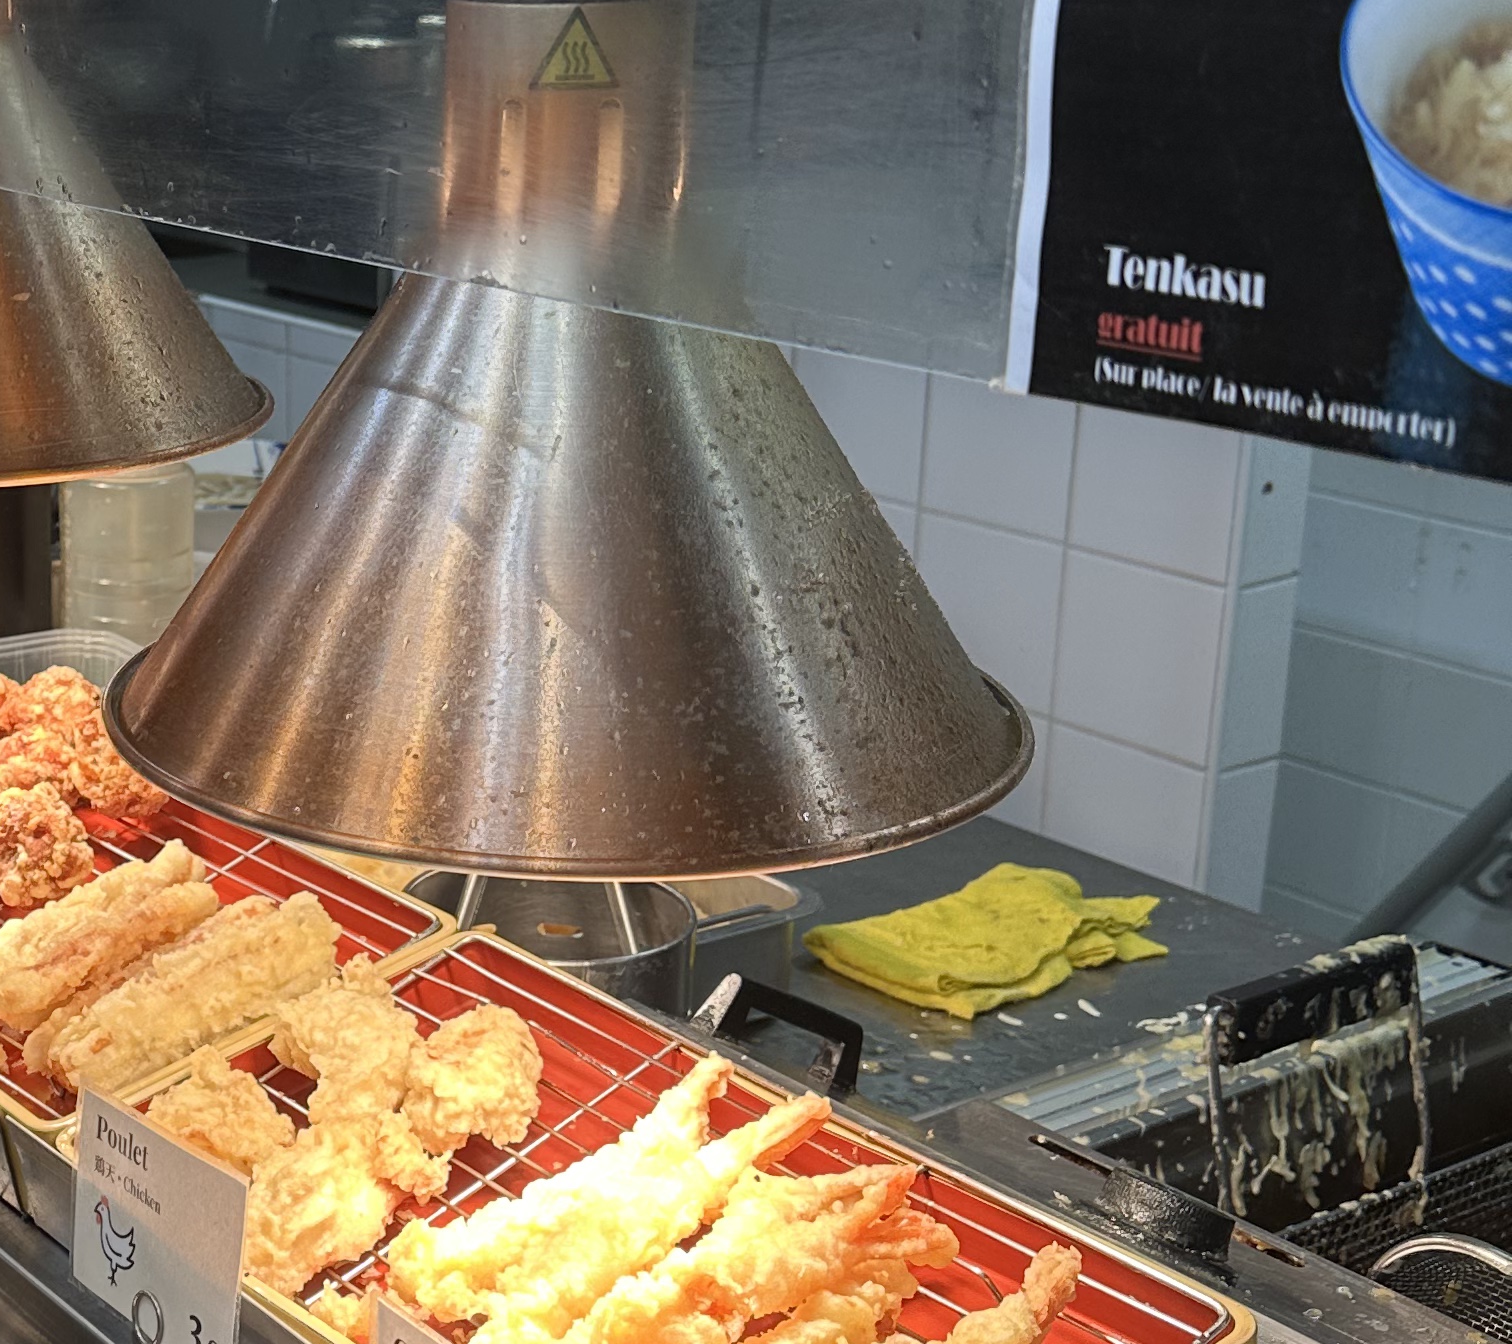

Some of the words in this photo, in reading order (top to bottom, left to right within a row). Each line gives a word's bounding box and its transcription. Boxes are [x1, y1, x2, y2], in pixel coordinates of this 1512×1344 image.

[1102, 243, 1267, 309] Tenkasu
[1096, 311, 1203, 356] gratuit
[1094, 355, 1138, 388] (Sur
[1212, 375, 1238, 406] la
[1240, 383, 1304, 416] vente
[1306, 391, 1325, 422] à
[1326, 401, 1457, 449] emporter)
[96, 1114, 149, 1171] Poulet
[123, 1175, 161, 1216] Chicken
